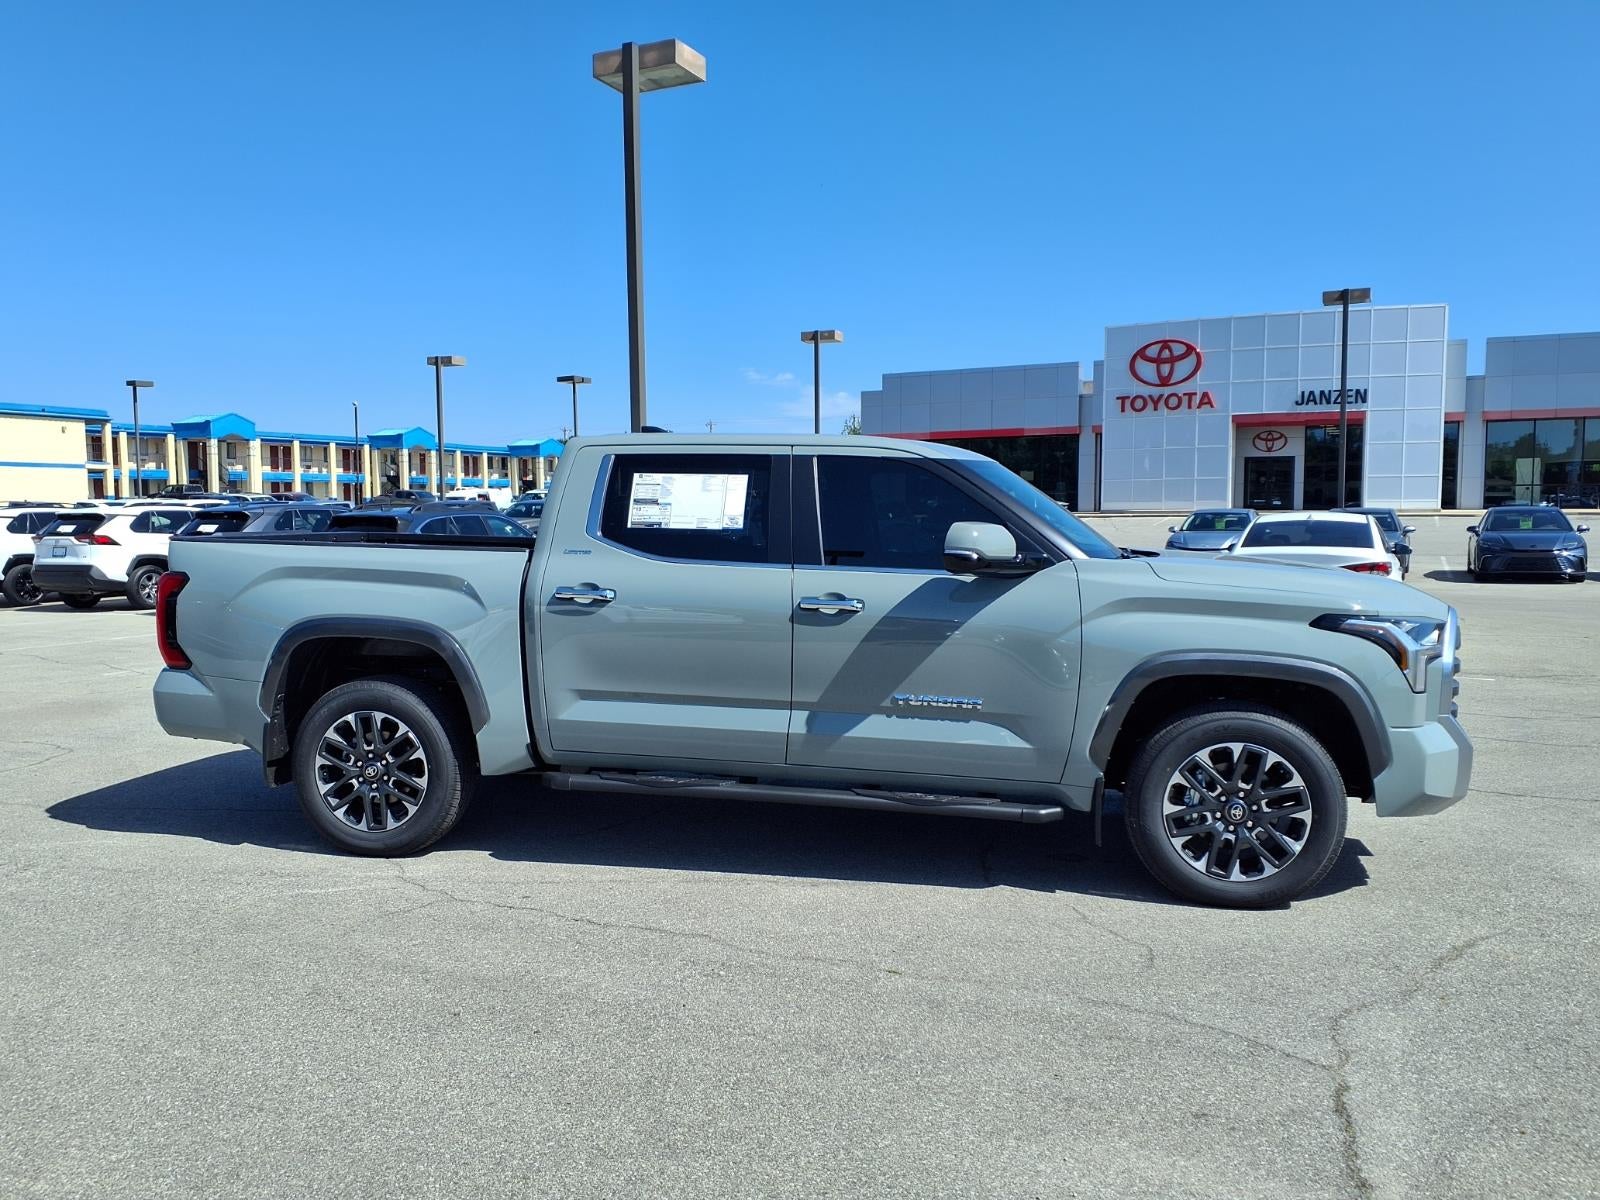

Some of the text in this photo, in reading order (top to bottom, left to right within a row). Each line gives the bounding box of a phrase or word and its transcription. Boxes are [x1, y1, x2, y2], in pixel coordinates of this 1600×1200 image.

[1116, 392, 1214, 413] TOYOTA
[1295, 388, 1368, 406] JANZEN
[894, 694, 983, 709] TUNDRA
